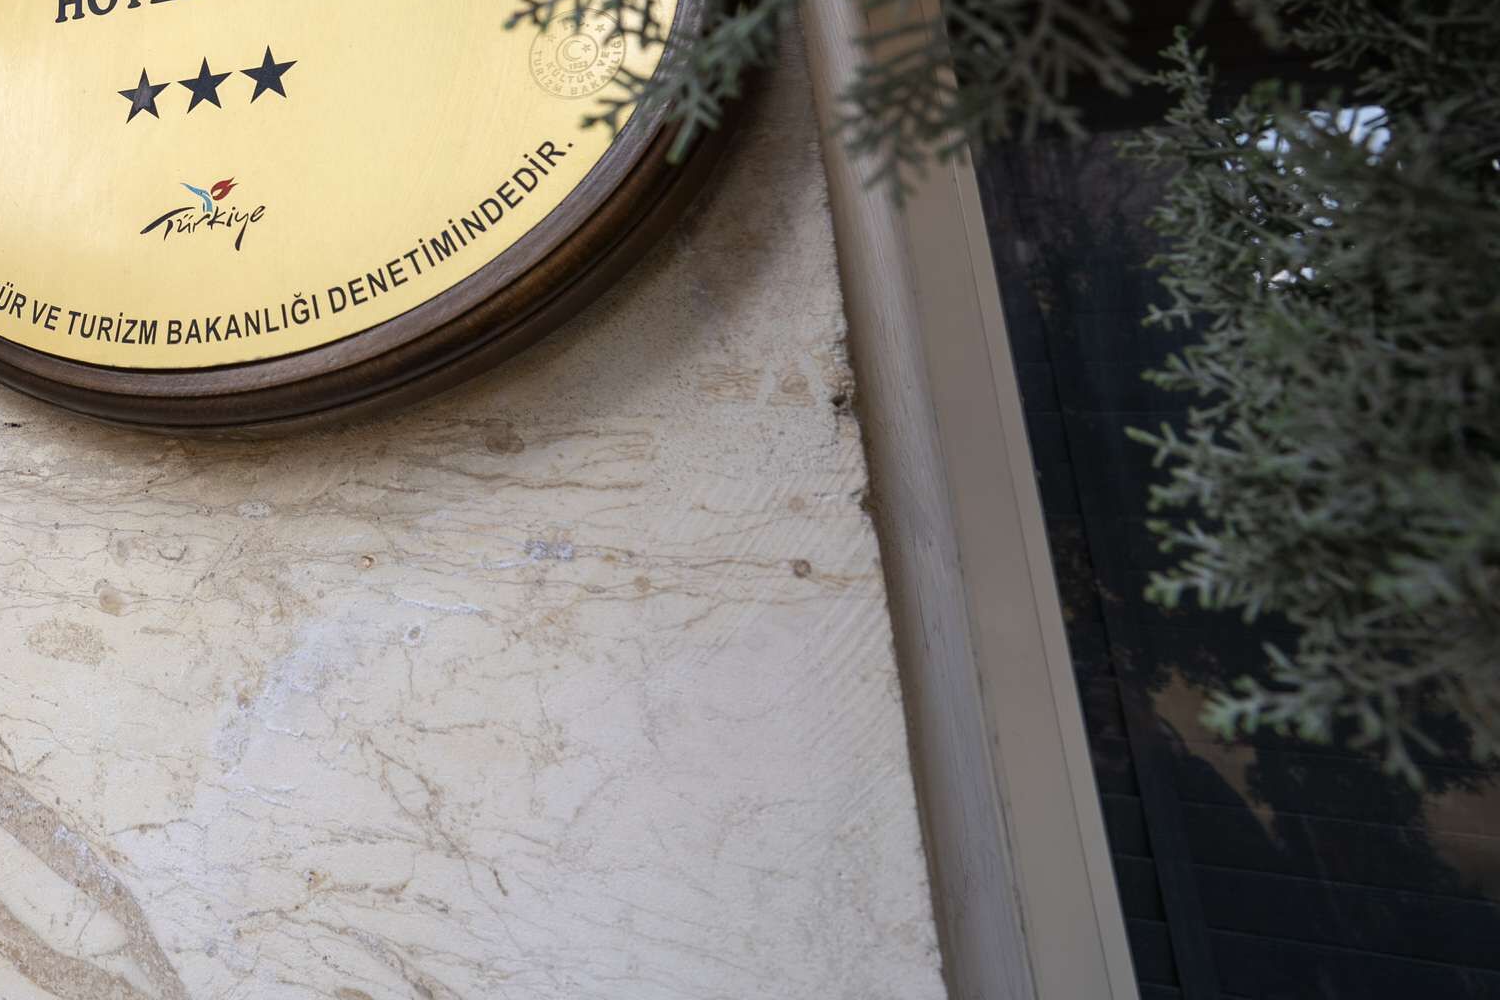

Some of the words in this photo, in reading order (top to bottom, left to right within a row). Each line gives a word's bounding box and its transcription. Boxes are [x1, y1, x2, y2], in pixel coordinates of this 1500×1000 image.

[32, 300, 62, 331] VE
[67, 310, 158, 345] TURİZM
[166, 291, 321, 345] BAKANLIĞI
[327, 140, 575, 314] DENETİMİNDEDİR.
[140, 205, 266, 251] Türkiye
